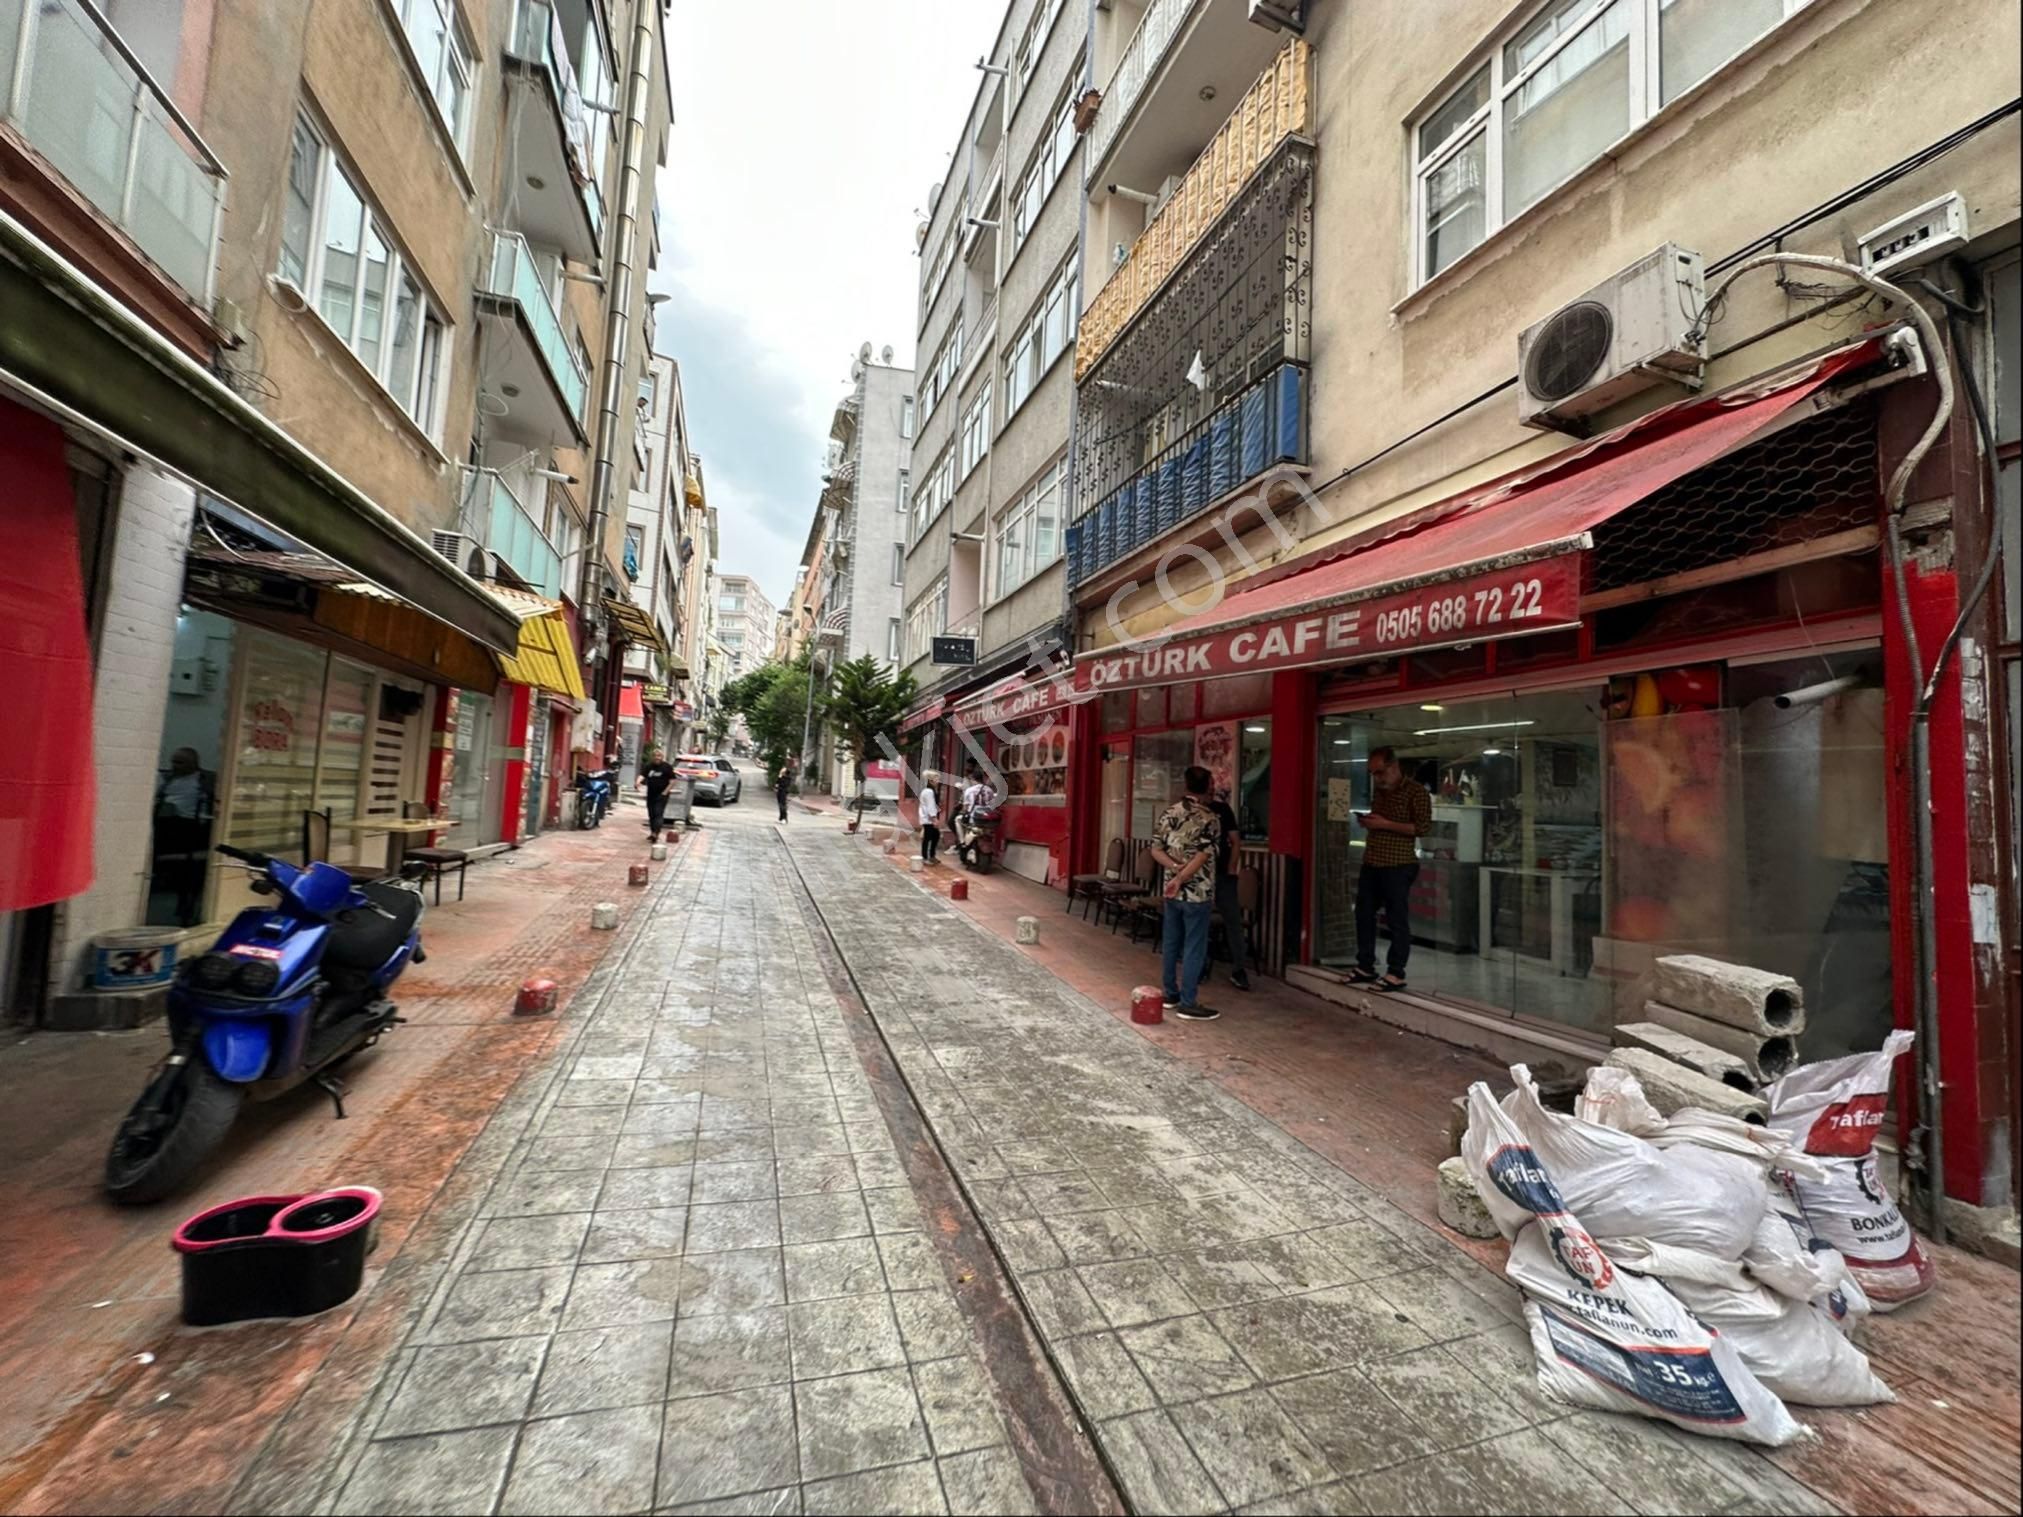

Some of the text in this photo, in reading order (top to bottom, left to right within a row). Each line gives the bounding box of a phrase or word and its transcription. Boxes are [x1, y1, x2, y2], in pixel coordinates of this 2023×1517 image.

[1229, 609, 1361, 663] CAFE
[1377, 605, 1421, 643] 0505
[1428, 595, 1466, 633] 688
[1474, 587, 1502, 625] 72
[1509, 578, 1542, 619] 22
[1013, 687, 1049, 713] CAFE
[1567, 1288, 1634, 1317] KEPEK
[1653, 1360, 1693, 1385] 35
